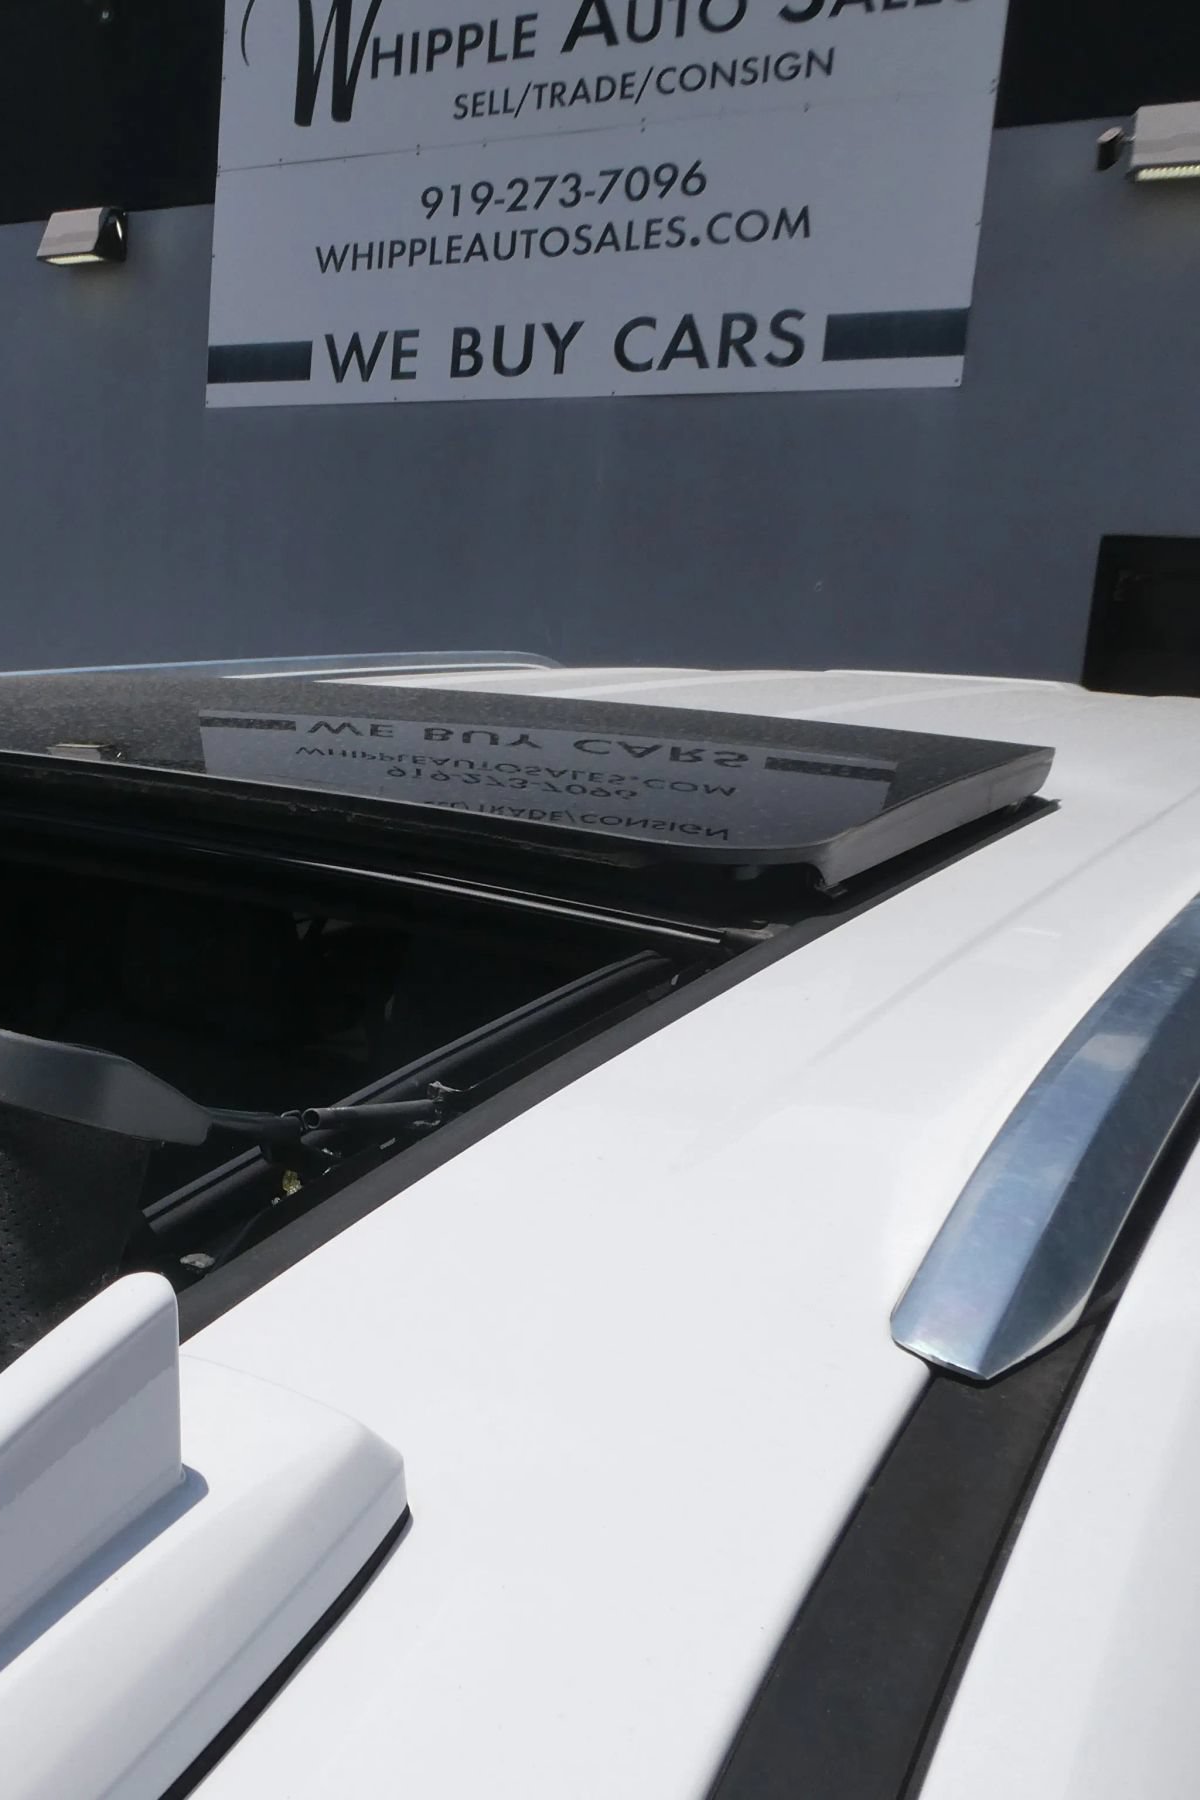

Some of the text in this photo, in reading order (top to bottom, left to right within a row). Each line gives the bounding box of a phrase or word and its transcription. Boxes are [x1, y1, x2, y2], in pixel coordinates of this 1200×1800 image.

[241, 0, 747, 127] WHIPPLE AUTO
[452, 47, 836, 121] SELL/TRADE/CONSIGN
[420, 159, 708, 220] 919-273-7096
[315, 206, 812, 275] WHIPPLEAUTOSALES.COM
[324, 310, 807, 384] WE BUY CARS
